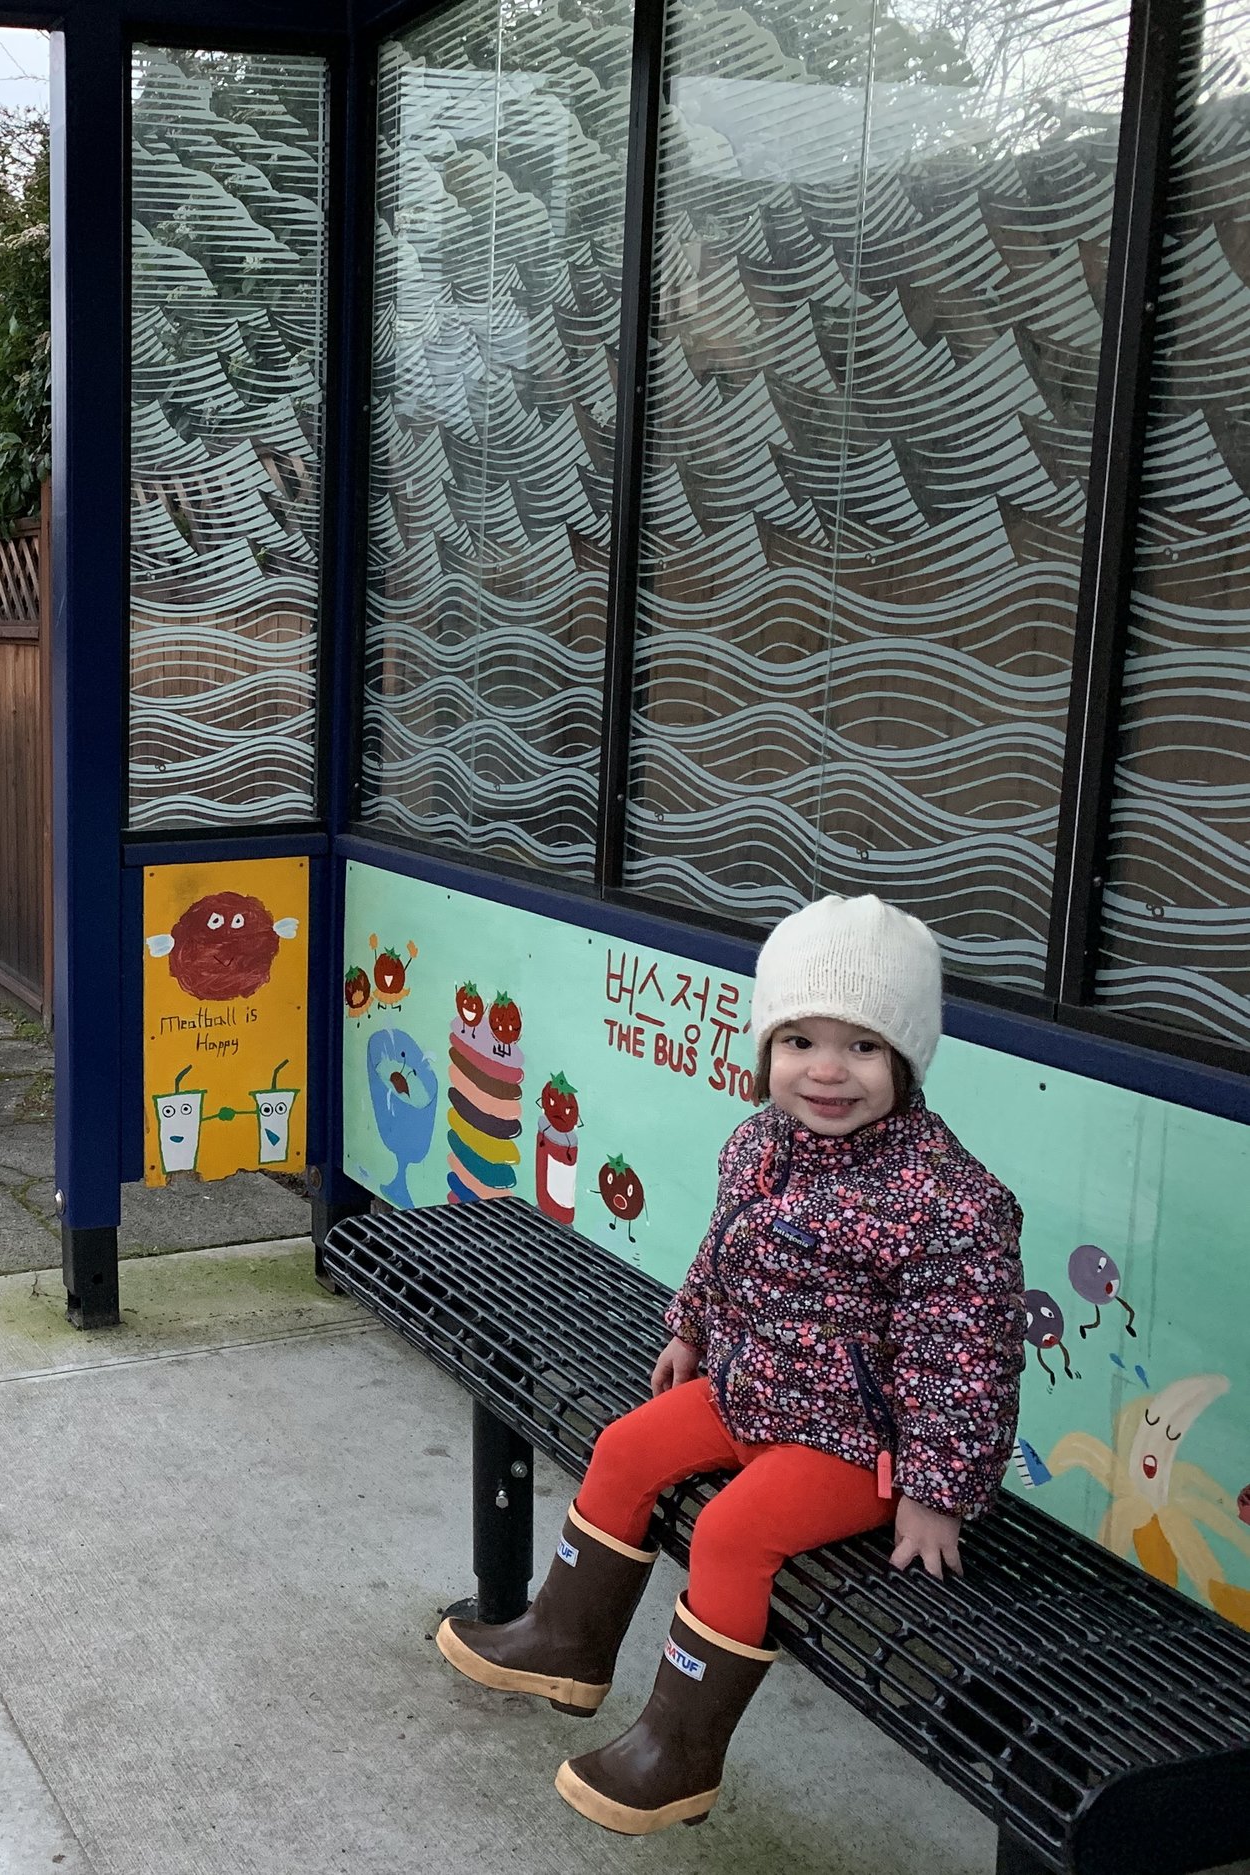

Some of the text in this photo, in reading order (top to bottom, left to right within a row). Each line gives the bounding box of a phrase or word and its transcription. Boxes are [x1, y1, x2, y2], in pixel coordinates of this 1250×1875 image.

[606, 948, 751, 1063] 버스정류
[160, 1006, 258, 1035] Meatball is
[196, 1032, 239, 1058] Happy
[604, 1018, 645, 1059] THE
[654, 1032, 698, 1077] BUS
[772, 1226, 809, 1248] patagonia
